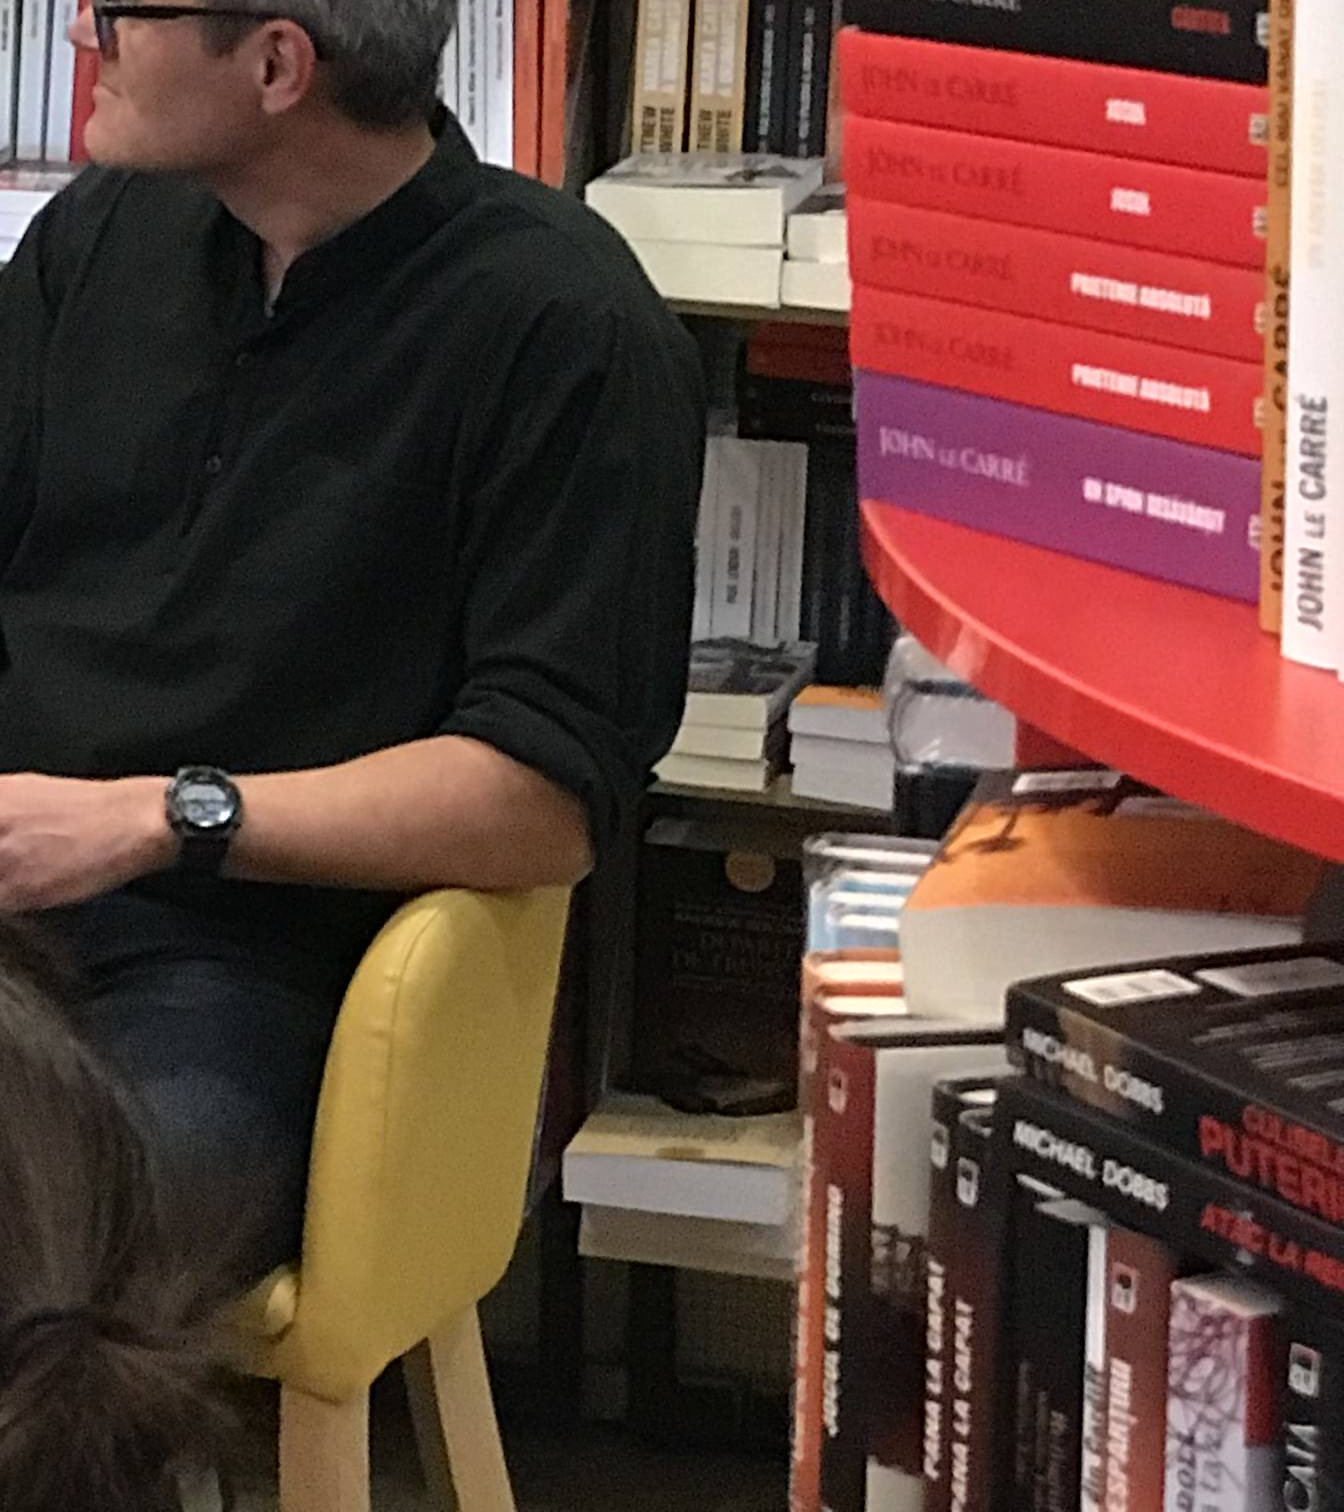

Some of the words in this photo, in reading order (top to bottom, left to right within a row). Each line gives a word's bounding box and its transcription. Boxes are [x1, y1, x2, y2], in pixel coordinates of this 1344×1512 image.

[879, 424, 935, 460] JOHN
[960, 445, 1030, 488] CARRÉ
[1294, 393, 1328, 502] CARRÉ
[1304, 512, 1324, 539] LE
[1296, 548, 1324, 631] JOHN
[1023, 1028, 1097, 1083] MICHAEL
[1103, 1063, 1163, 1114] DOBBS
[1014, 1120, 1096, 1180] MICHAEL
[1102, 1158, 1169, 1211] DOBBS
[925, 1358, 943, 1395] LA
[952, 1398, 971, 1435] LA
